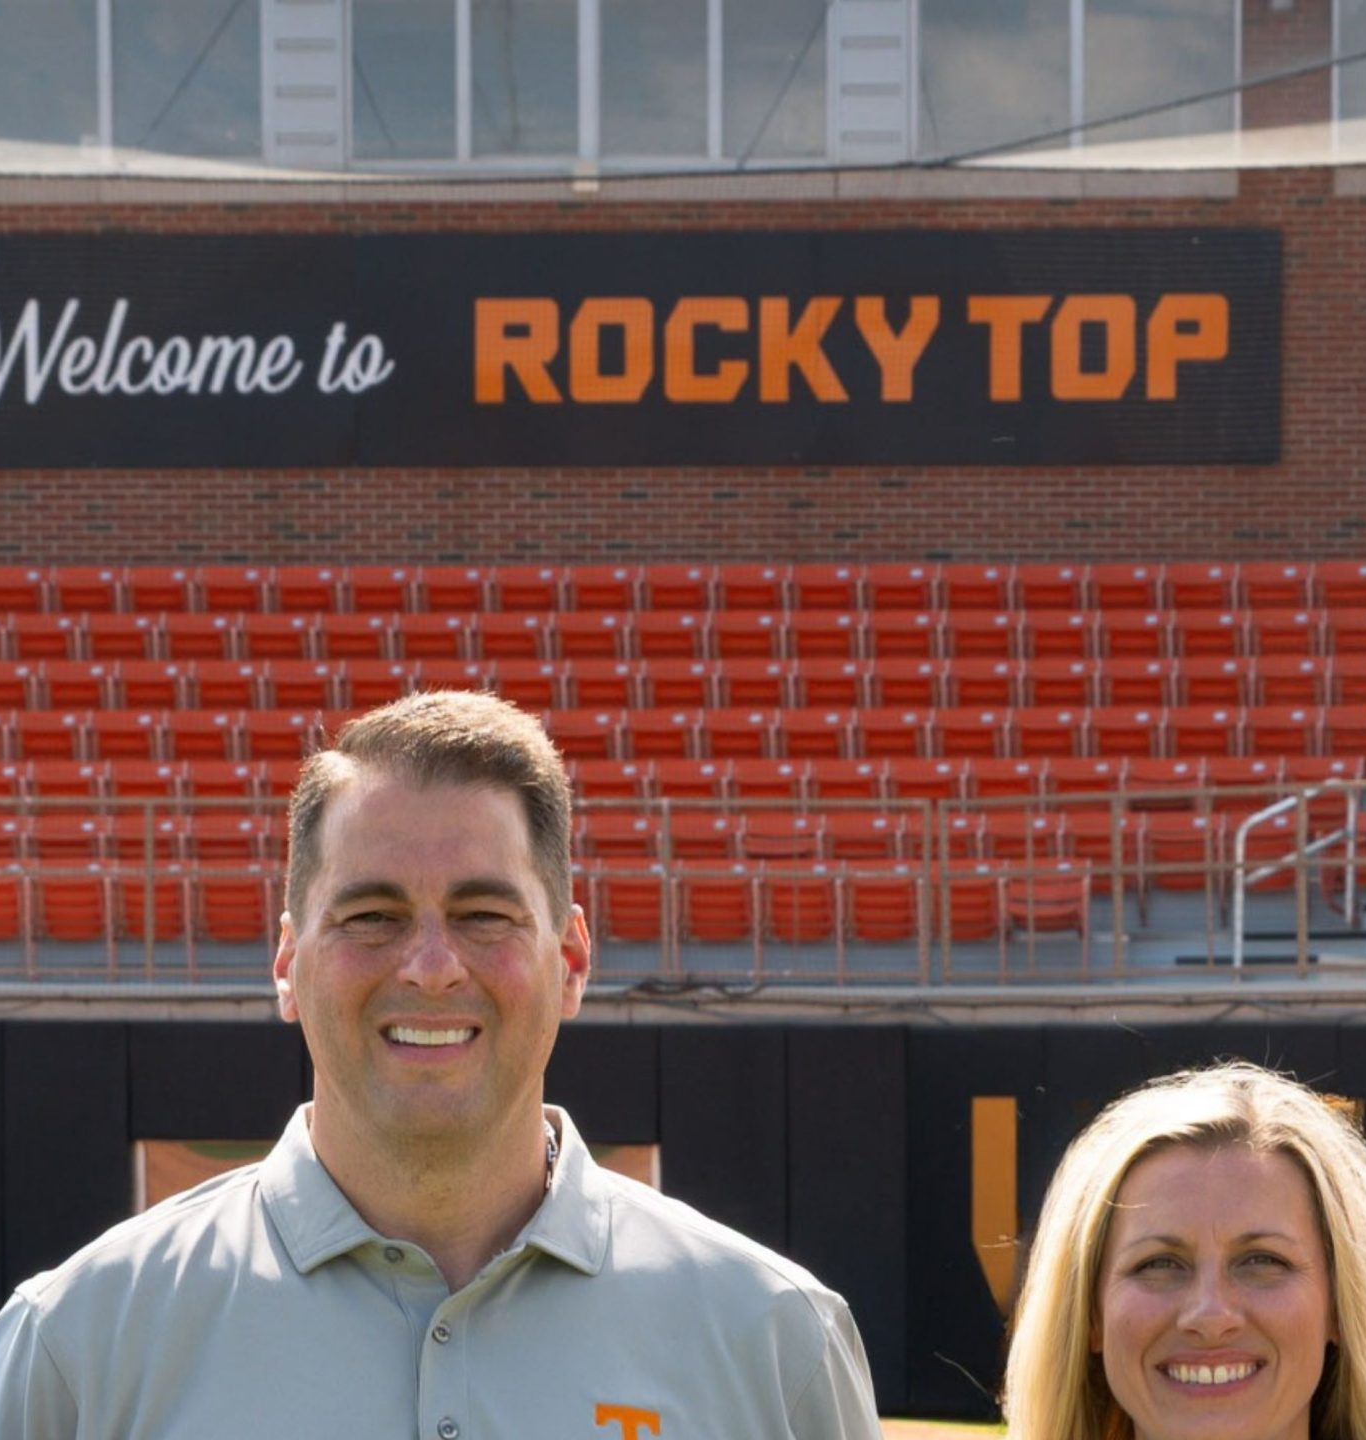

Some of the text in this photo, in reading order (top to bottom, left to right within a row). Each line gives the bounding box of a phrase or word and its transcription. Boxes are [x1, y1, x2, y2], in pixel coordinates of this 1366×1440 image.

[316, 320, 396, 395] to
[473, 294, 942, 406] ROCKY
[965, 292, 1231, 404] TOP
